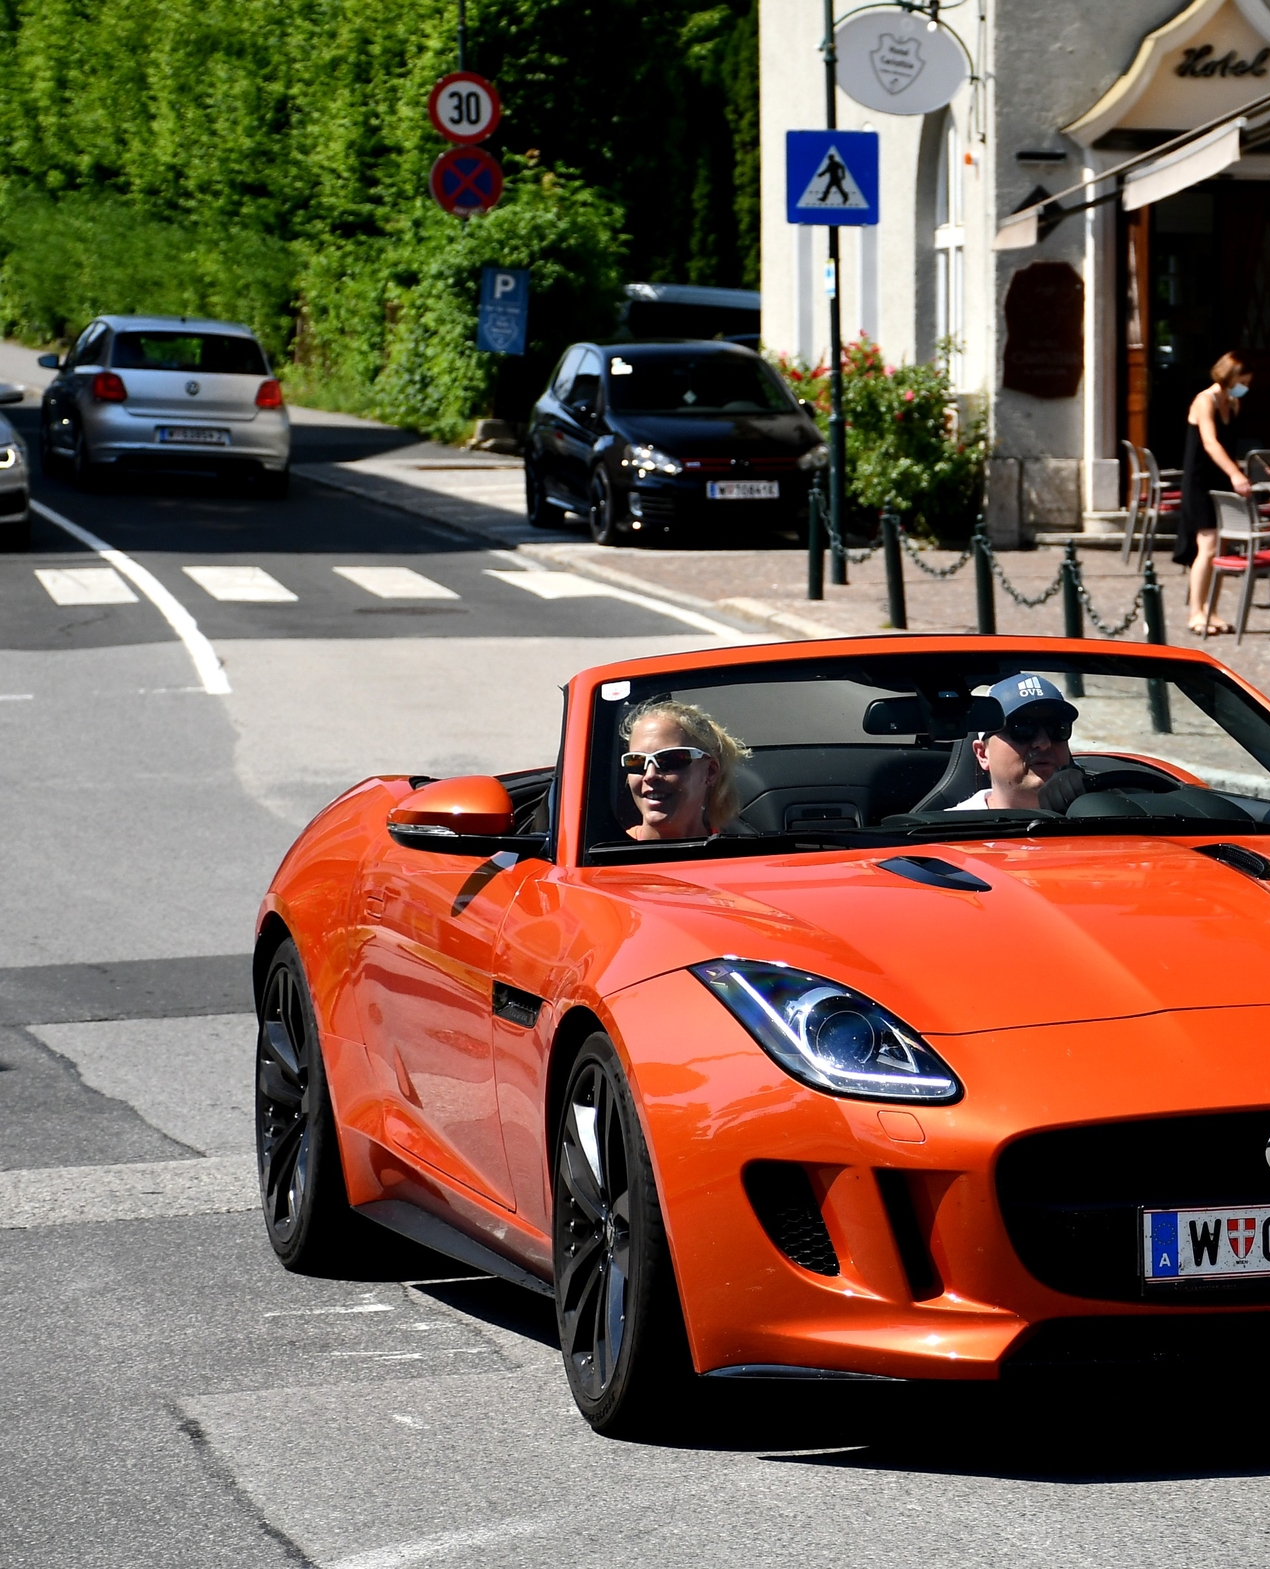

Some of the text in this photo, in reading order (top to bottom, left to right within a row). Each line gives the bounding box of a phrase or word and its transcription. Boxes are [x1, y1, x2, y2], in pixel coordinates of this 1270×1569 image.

[448, 90, 481, 125] 30
[494, 273, 516, 299] P
[1019, 688, 1044, 697] OVB
[1188, 1217, 1222, 1268] W
[1158, 1253, 1172, 1268] A
